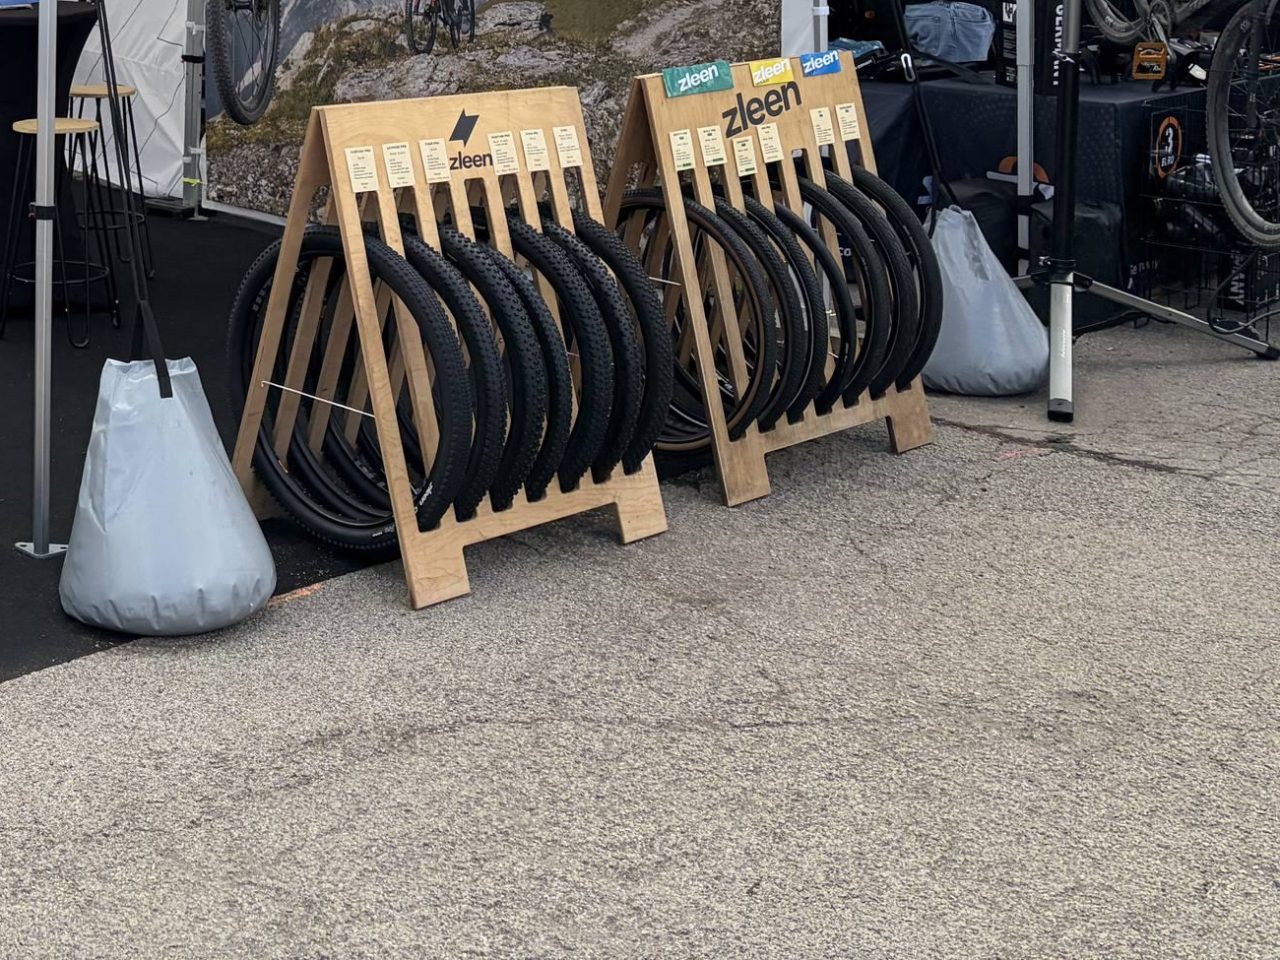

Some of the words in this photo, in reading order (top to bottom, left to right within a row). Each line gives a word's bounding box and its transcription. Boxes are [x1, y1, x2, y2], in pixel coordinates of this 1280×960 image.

[753, 58, 792, 84] zleen
[803, 50, 839, 75] zleen
[678, 64, 720, 92] zleen
[722, 80, 802, 139] zleen
[449, 151, 493, 171] zleen
